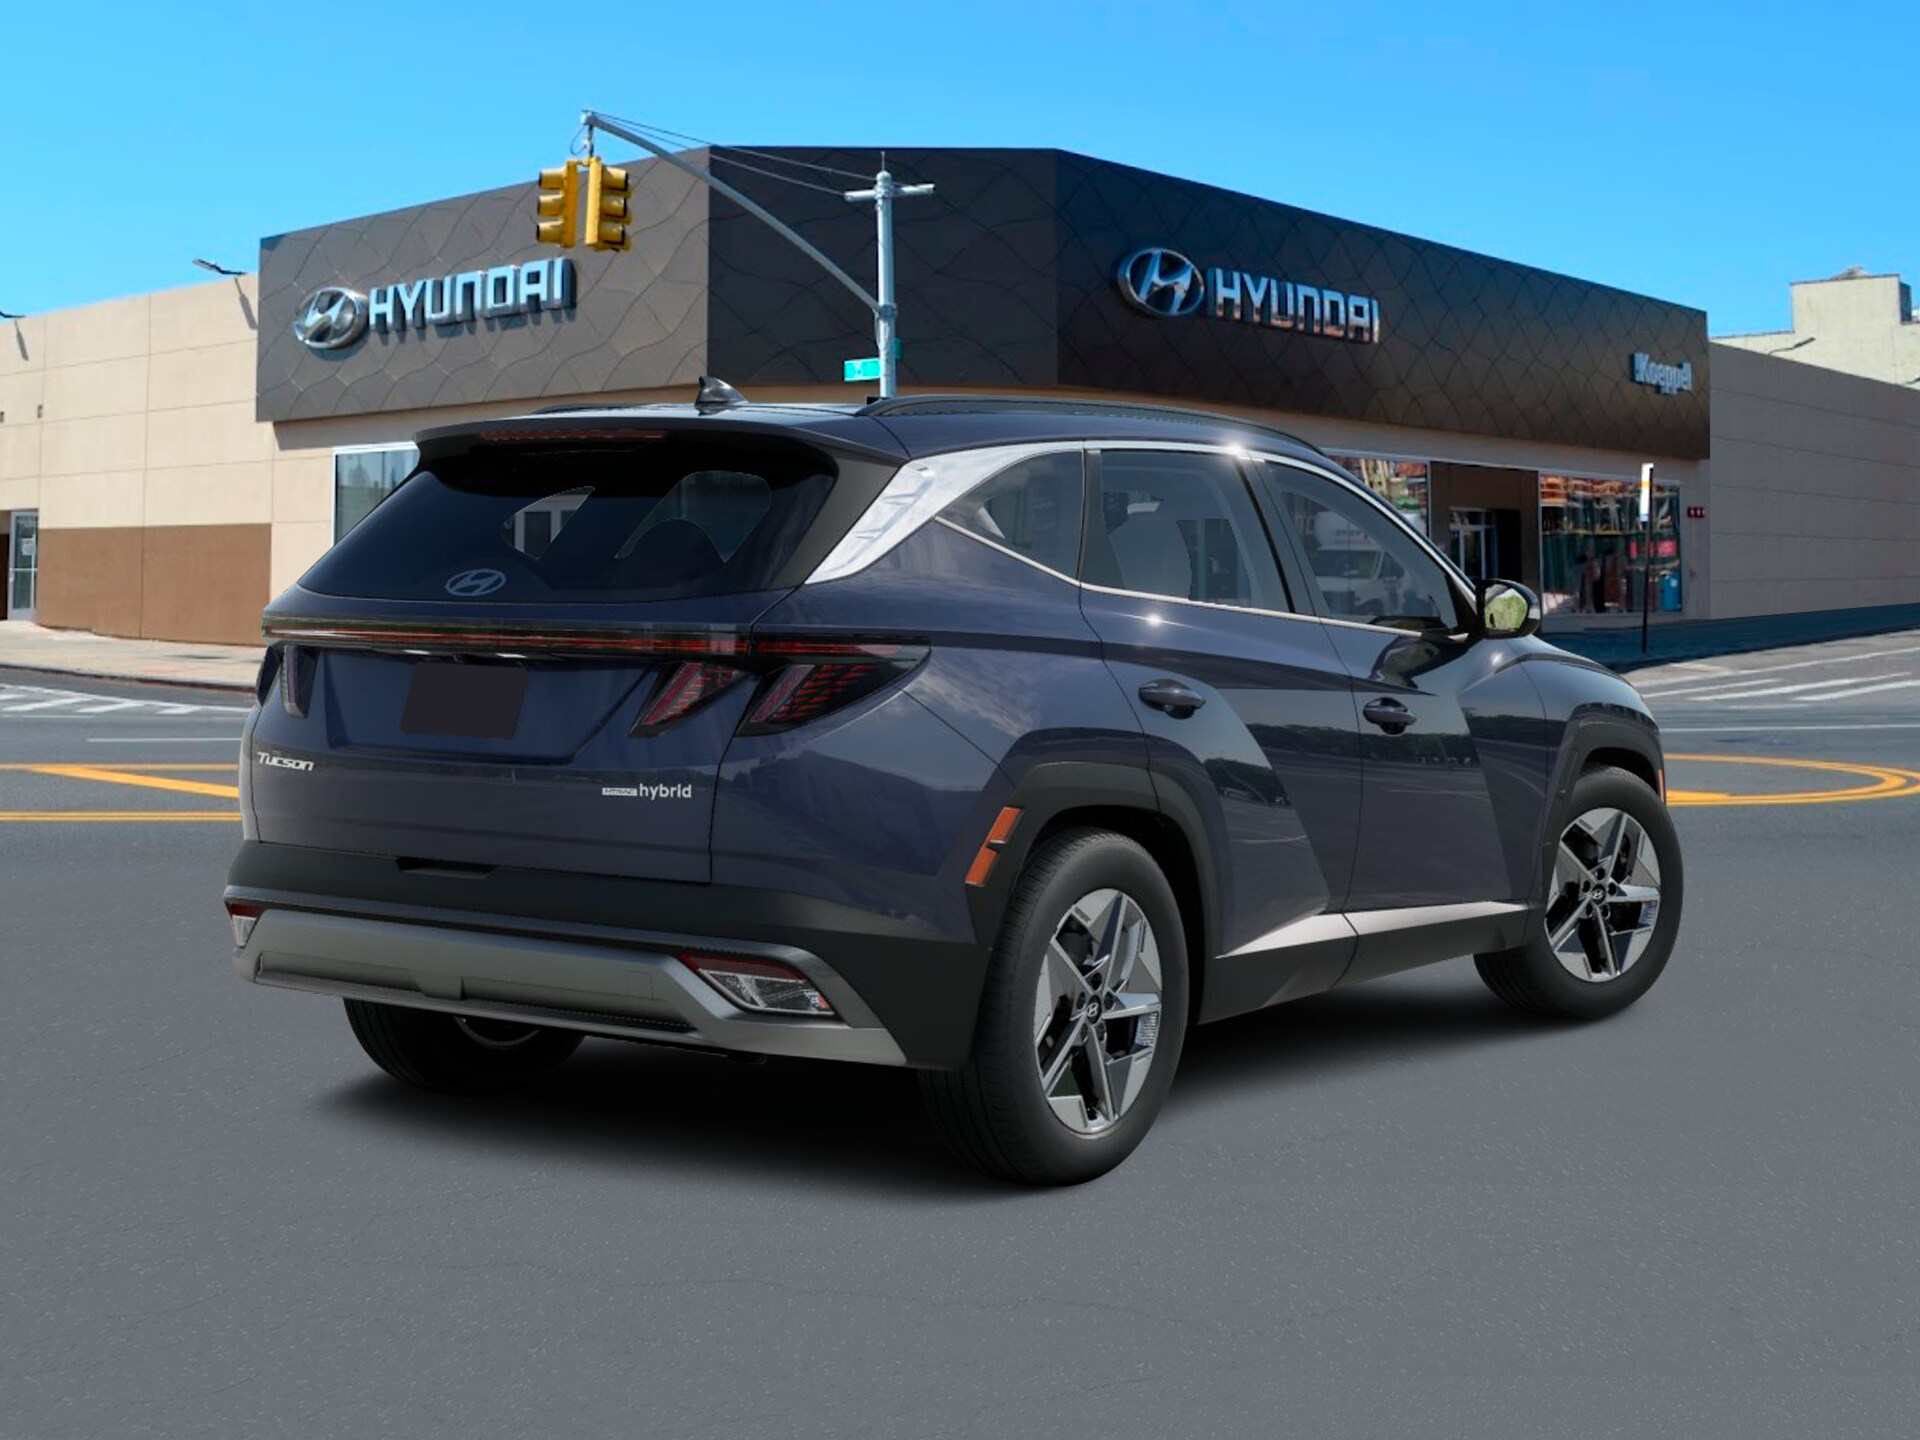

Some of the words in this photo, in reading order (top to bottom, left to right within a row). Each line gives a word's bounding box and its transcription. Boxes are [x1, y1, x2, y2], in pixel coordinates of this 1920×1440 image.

[368, 256, 576, 331] HYUNDAI
[1210, 267, 1380, 344] HYUNDAI
[639, 782, 692, 801] hybrid
